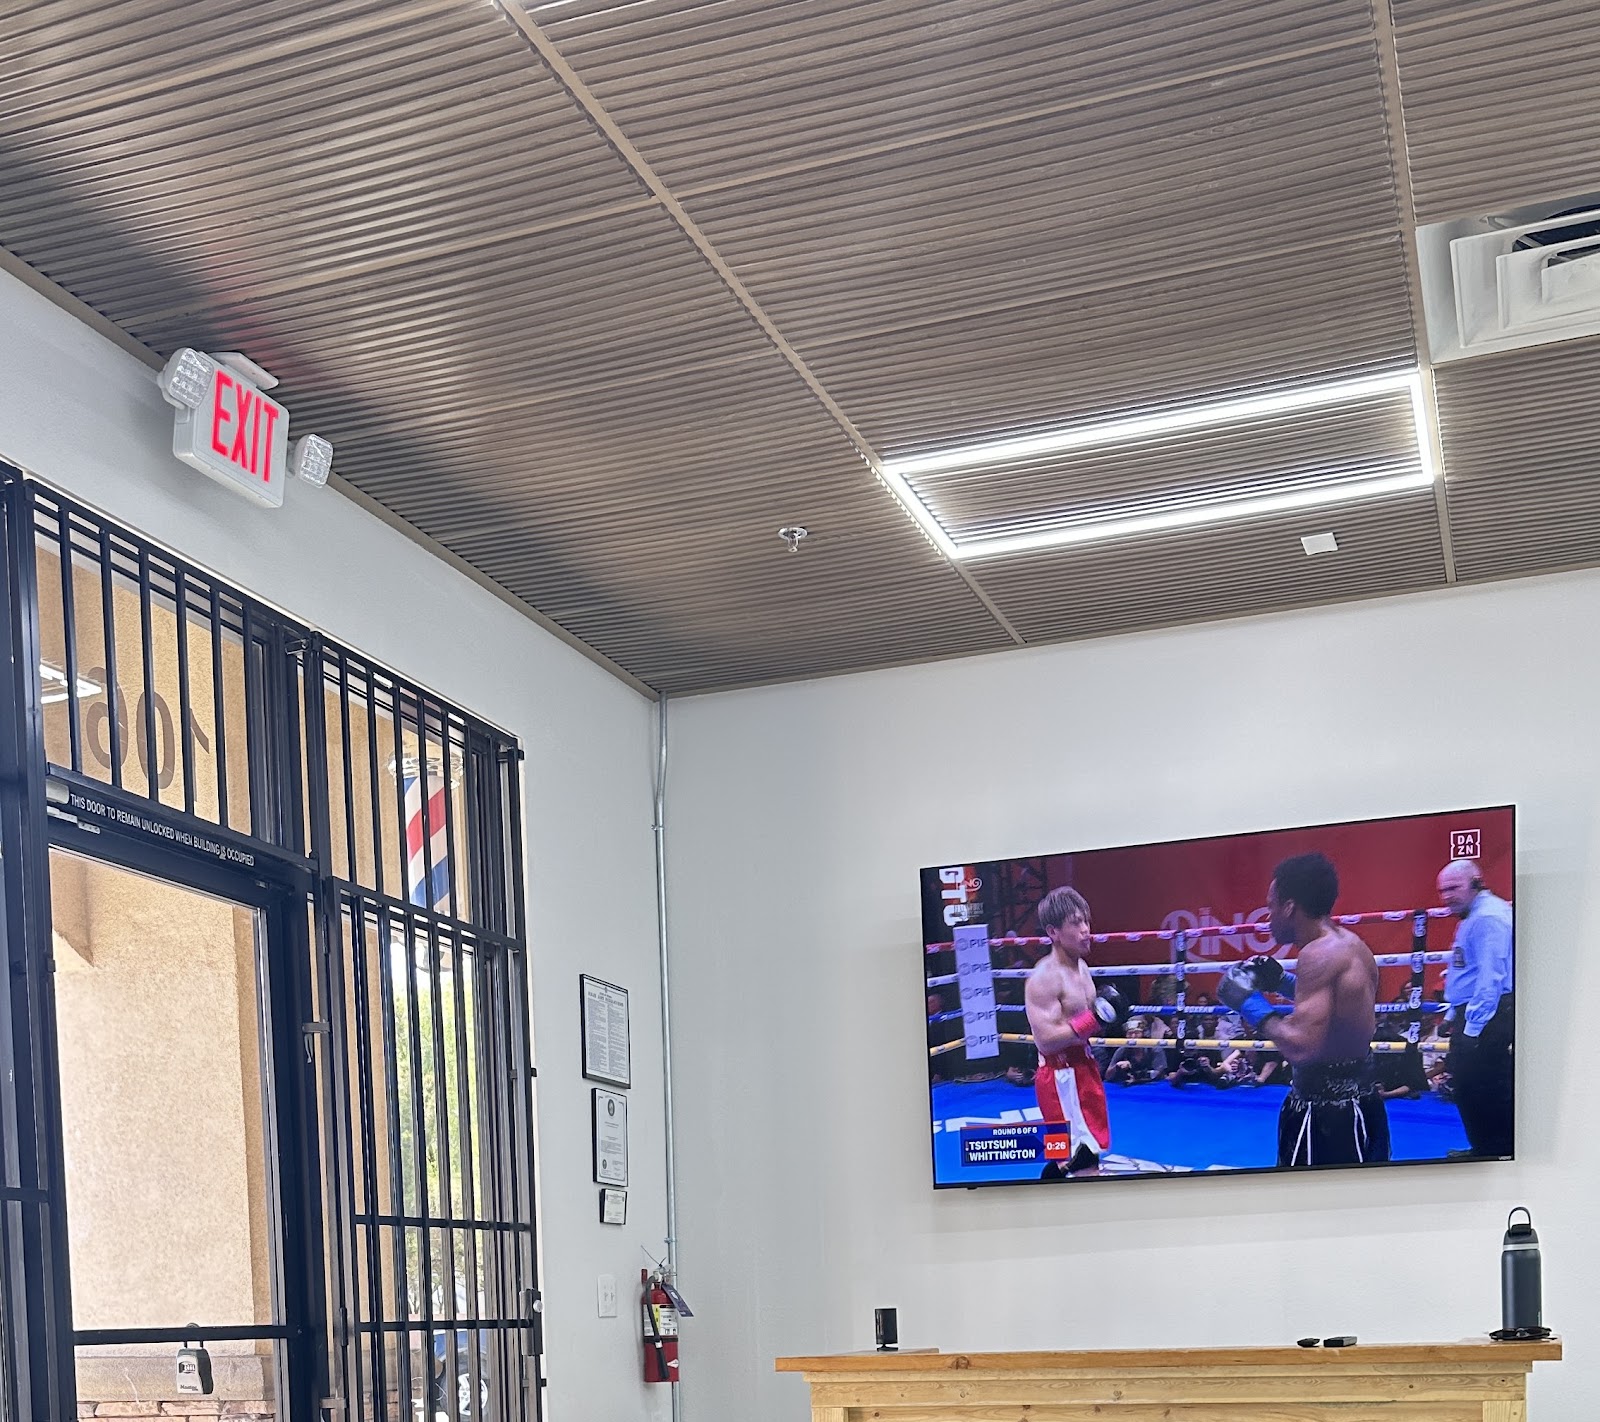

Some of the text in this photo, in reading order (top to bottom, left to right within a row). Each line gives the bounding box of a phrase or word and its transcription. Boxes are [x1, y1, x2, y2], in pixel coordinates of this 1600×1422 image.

[211, 369, 279, 483] EXIT
[70, 794, 85, 810] THIS
[86, 799, 106, 817] DOOR
[106, 806, 116, 820] TO
[116, 809, 141, 829] REMAIN
[141, 818, 175, 840] UNLOCKED
[175, 829, 193, 846] WHEN
[193, 835, 220, 855] BUILDING
[226, 847, 255, 867] OCCUPIED
[969, 1139, 1017, 1150] TSUTSUMI
[1046, 1142, 1066, 1151] 0:26
[969, 1149, 1036, 1161] WHITTINGTON
